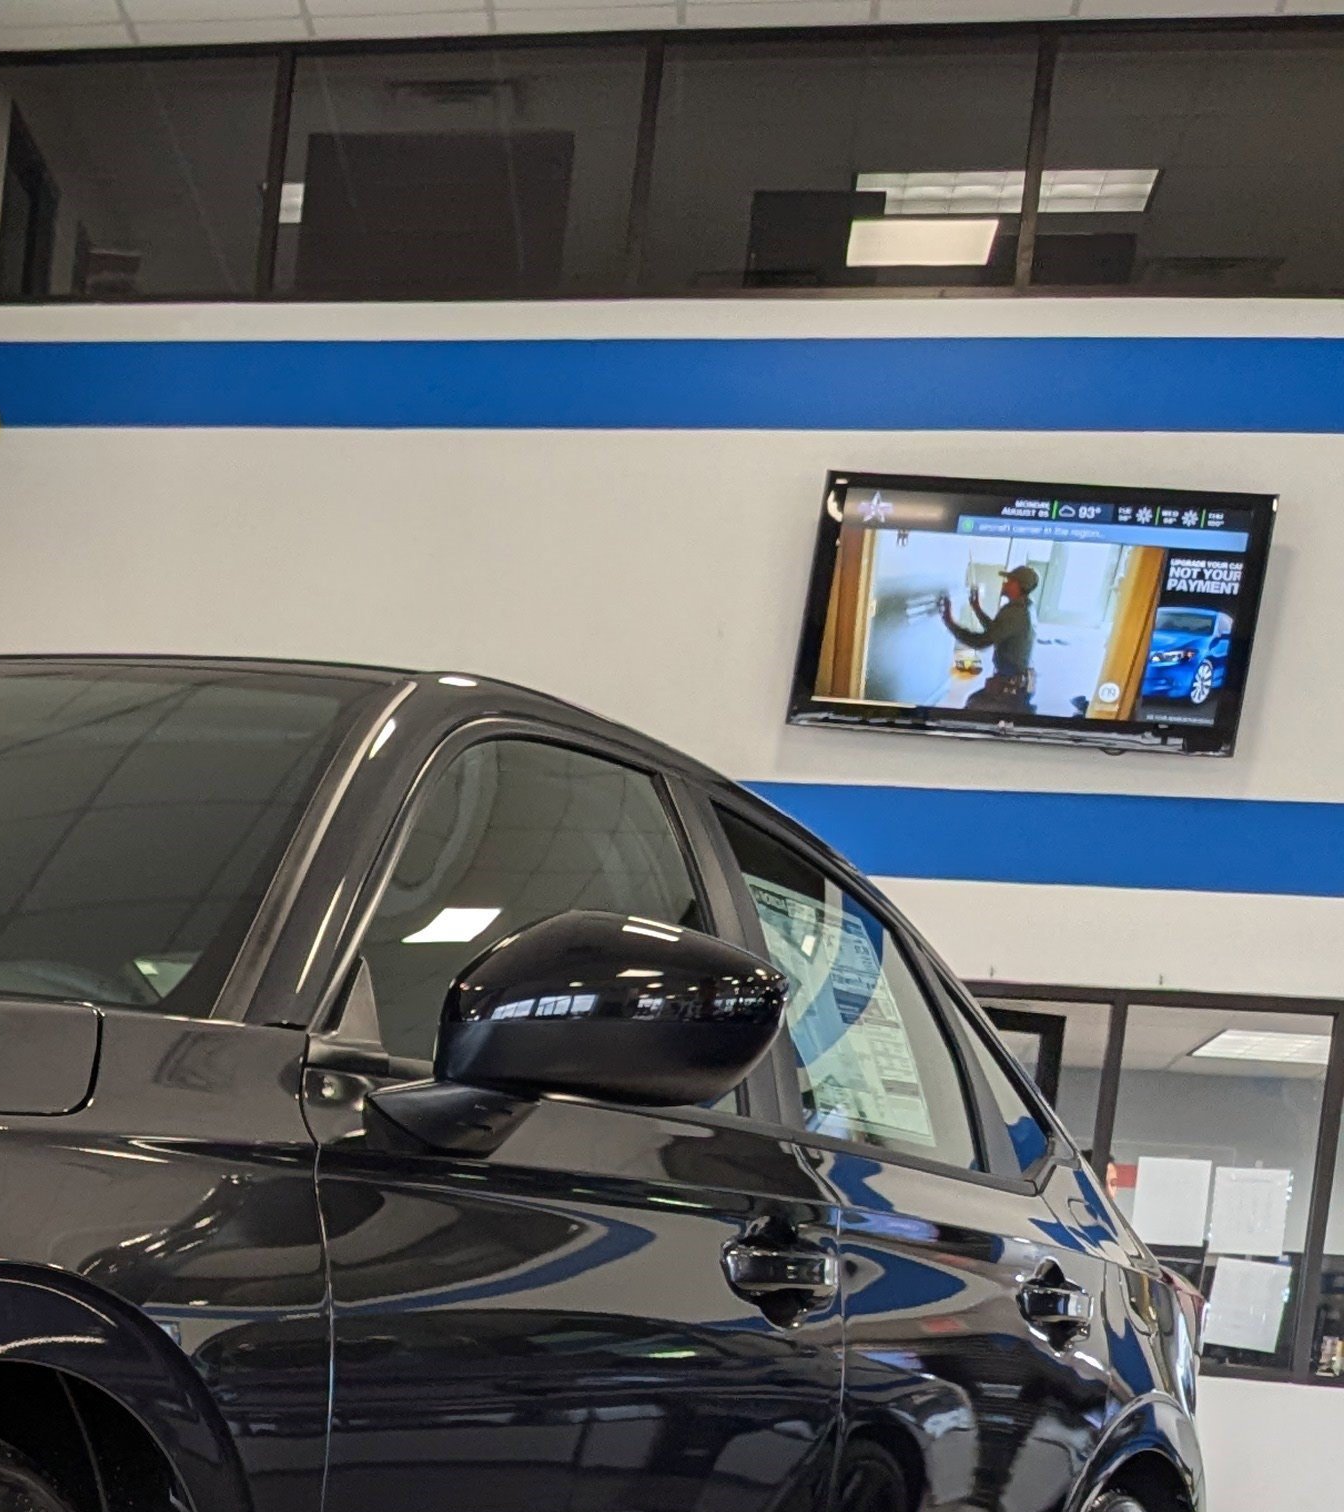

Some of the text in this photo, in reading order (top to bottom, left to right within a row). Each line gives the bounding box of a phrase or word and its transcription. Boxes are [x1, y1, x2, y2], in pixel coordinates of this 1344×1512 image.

[1169, 567, 1242, 582] NOT YOUR
[1166, 578, 1239, 595] PAYMENT
